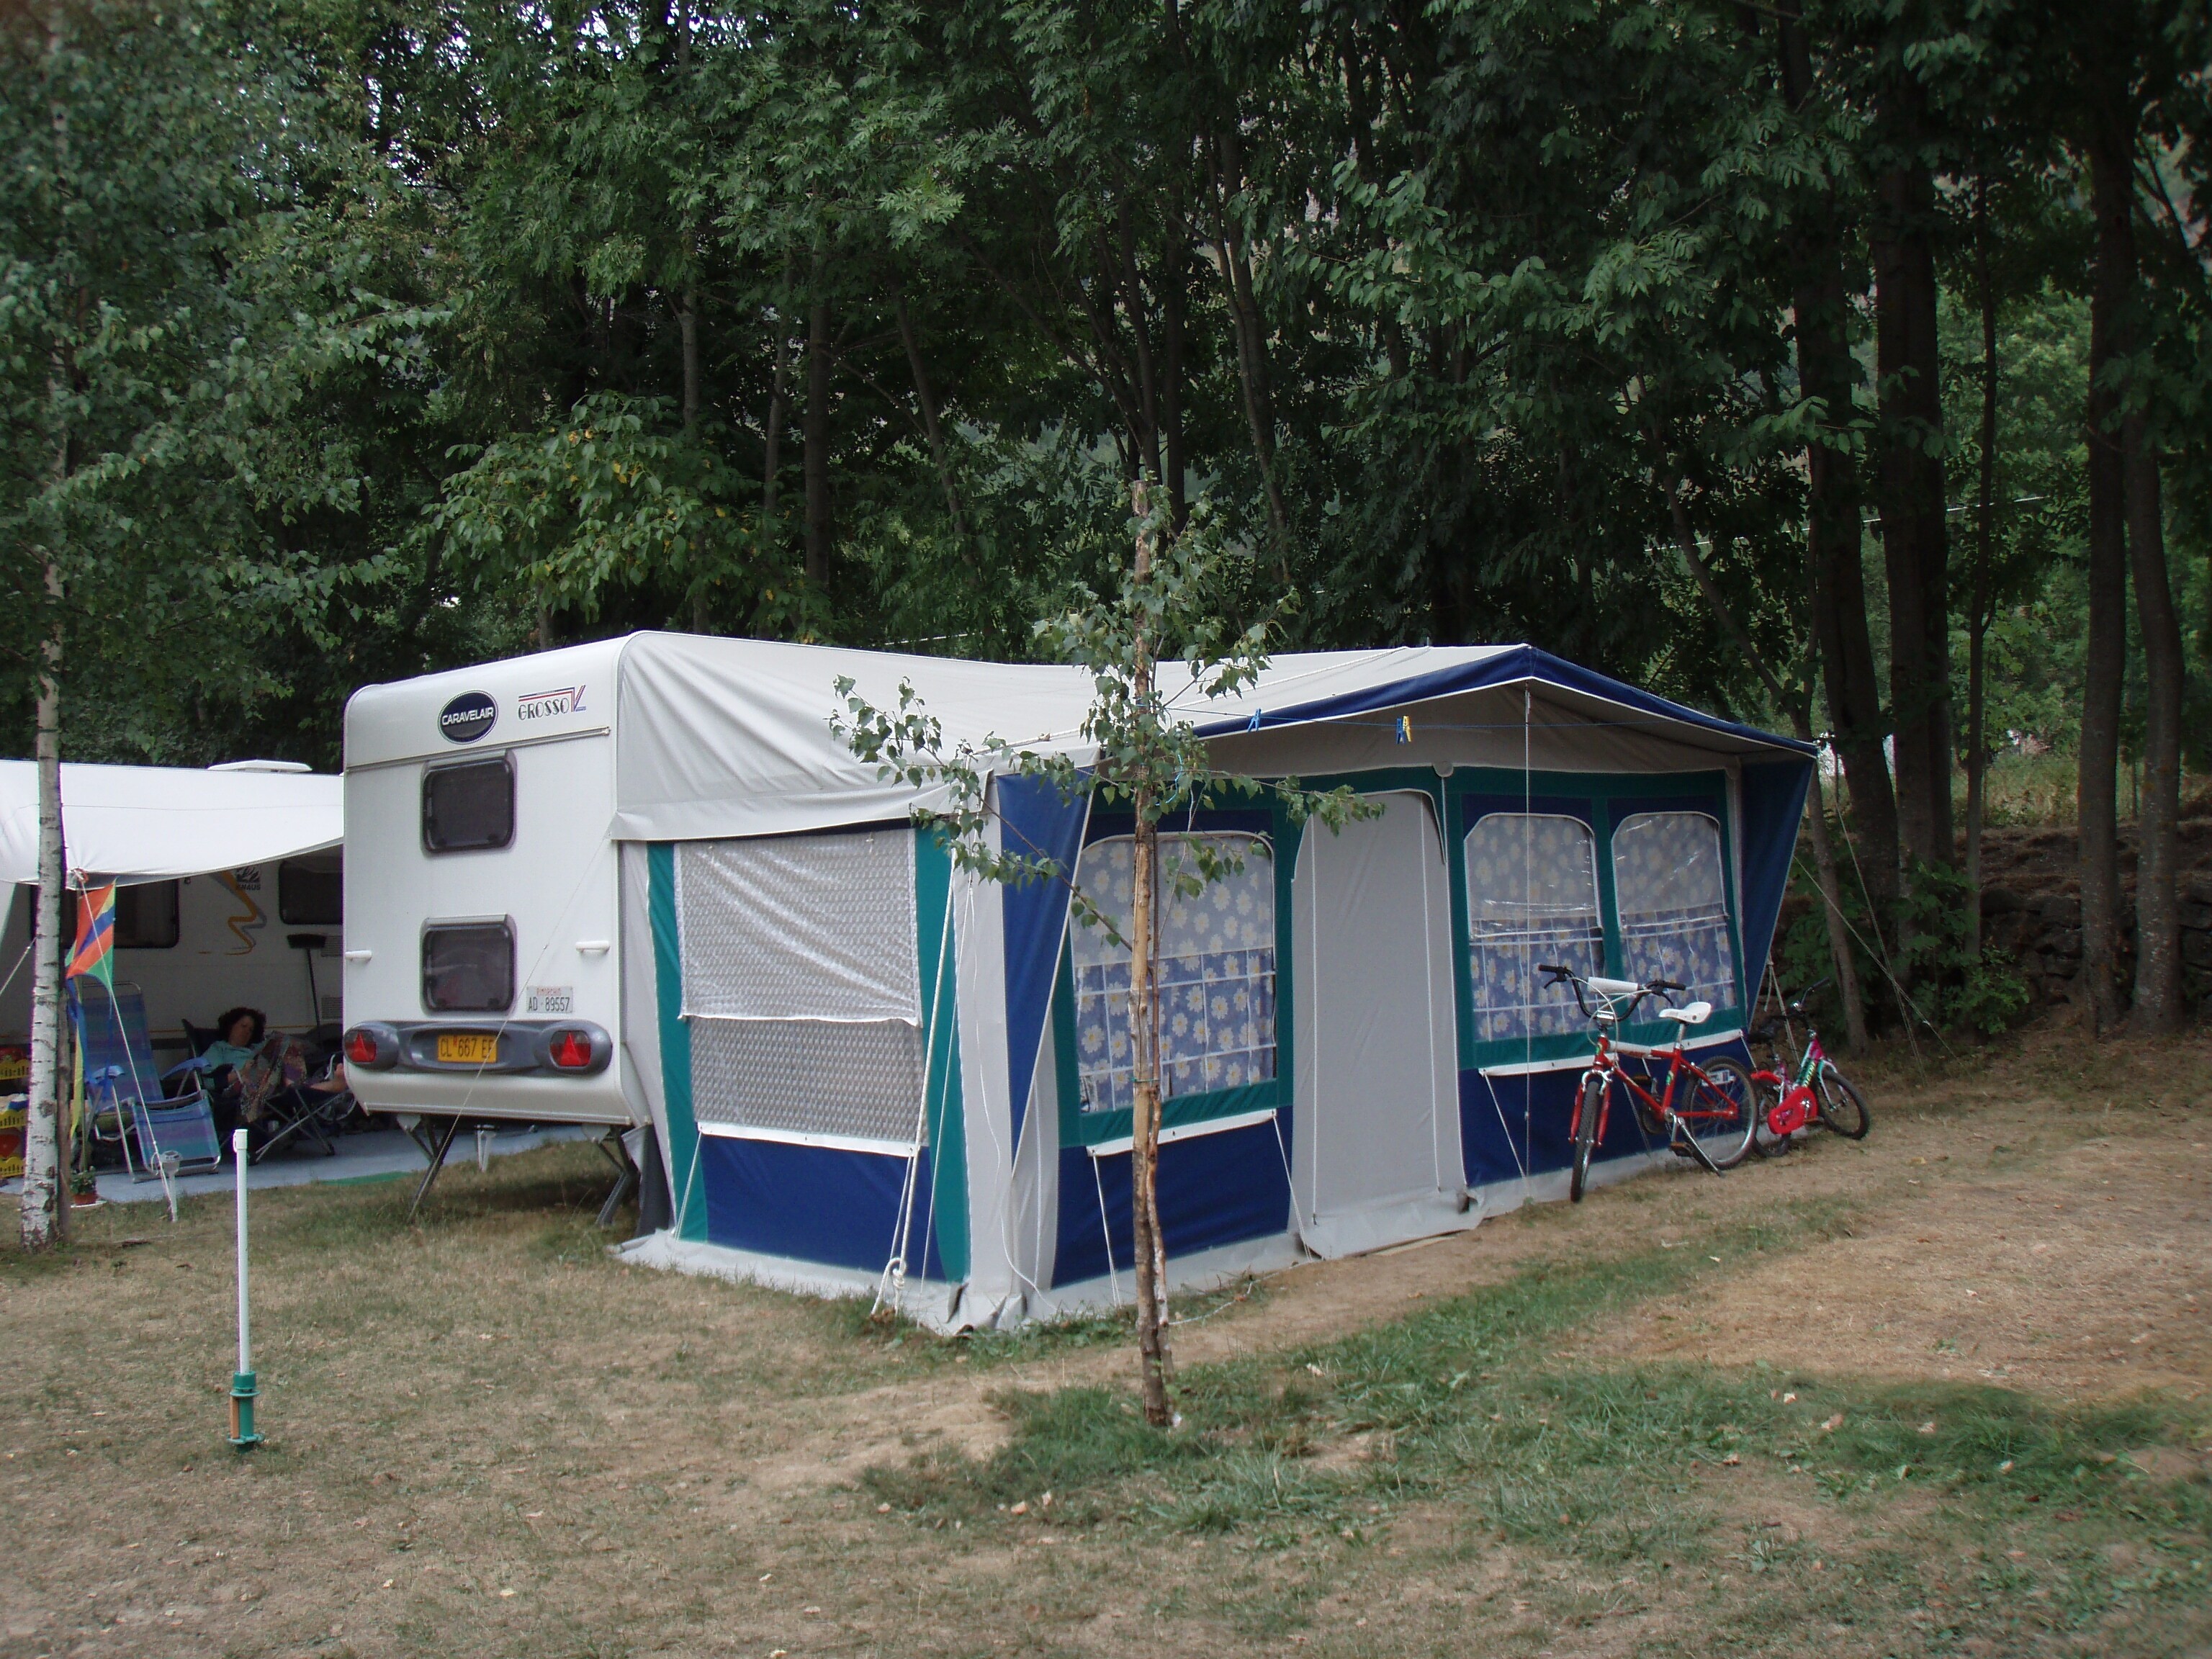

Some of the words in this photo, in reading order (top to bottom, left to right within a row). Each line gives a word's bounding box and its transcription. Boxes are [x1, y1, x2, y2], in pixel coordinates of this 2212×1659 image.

[441, 707, 494, 726] CARAVELAIR
[518, 697, 570, 720] GROSSO
[528, 997, 538, 1012] AD
[545, 997, 570, 1012] 89557
[440, 1038, 451, 1057] CL
[458, 1038, 477, 1057] 667
